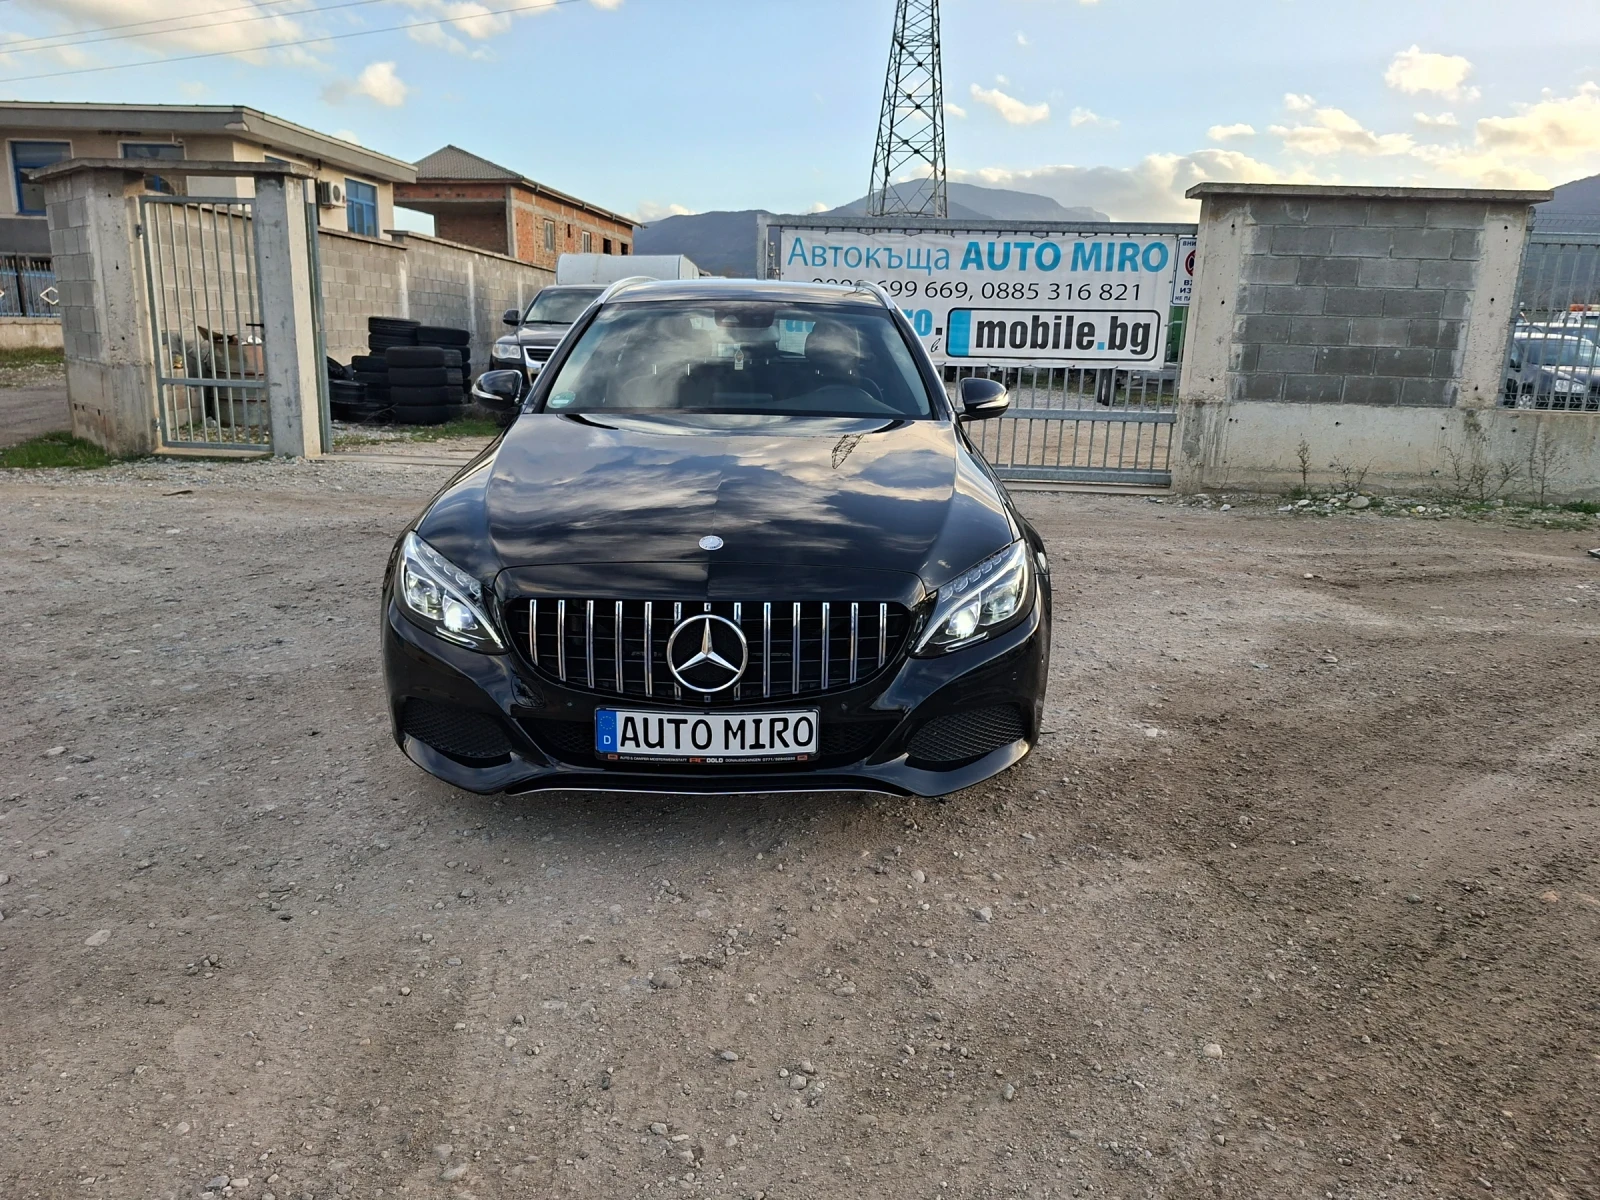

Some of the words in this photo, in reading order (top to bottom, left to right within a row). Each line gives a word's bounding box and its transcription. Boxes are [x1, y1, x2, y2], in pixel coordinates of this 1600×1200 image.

[787, 237, 950, 276] Автокъща
[960, 241, 1062, 272] AUTO
[1070, 241, 1169, 272] MIRO
[925, 281, 974, 302] 669,
[981, 282, 1039, 300] 0885
[1047, 283, 1092, 301] 316
[1099, 283, 1141, 301] 821
[975, 315, 1151, 355] mobile.bg
[603, 735, 612, 744] D
[619, 716, 713, 750] AUTO
[723, 716, 814, 750] MIRO
